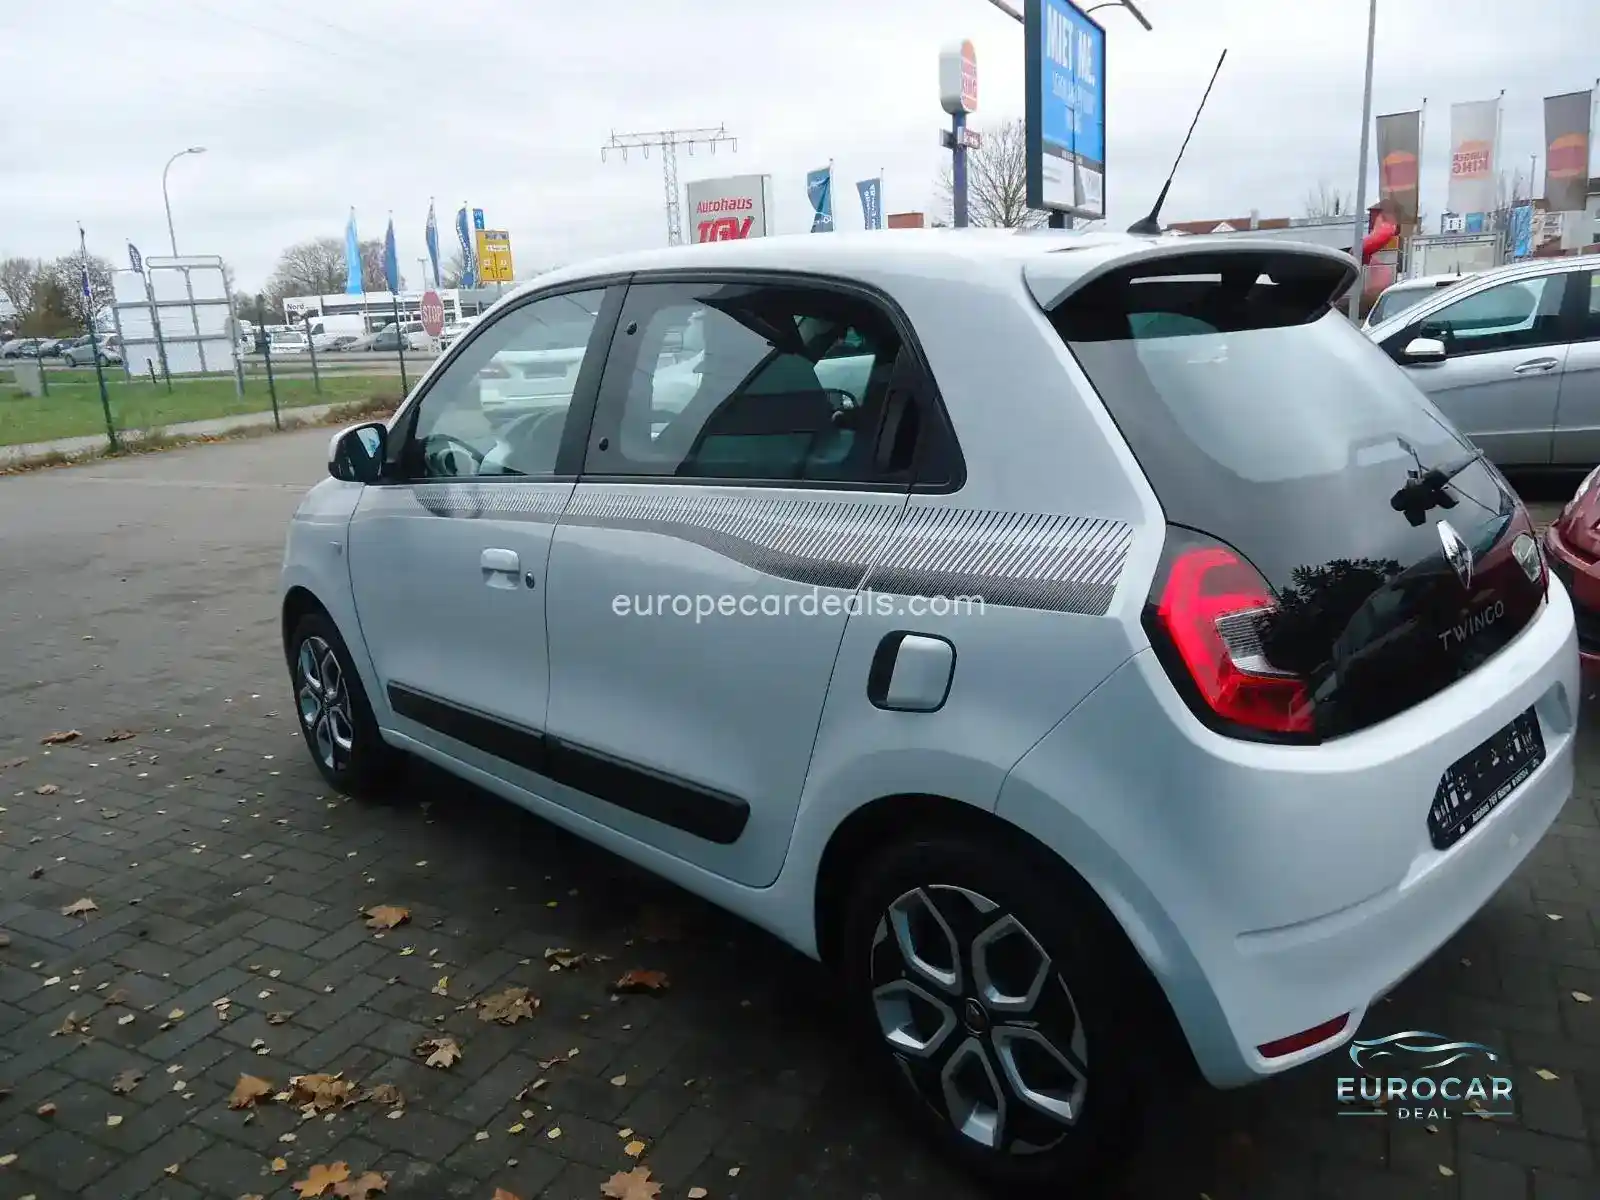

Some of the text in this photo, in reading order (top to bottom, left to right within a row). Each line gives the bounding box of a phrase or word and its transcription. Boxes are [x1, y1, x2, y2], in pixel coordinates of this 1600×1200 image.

[696, 197, 753, 214] Autohaus
[422, 304, 442, 323] STOP
[1438, 601, 1505, 651] TWINGO
